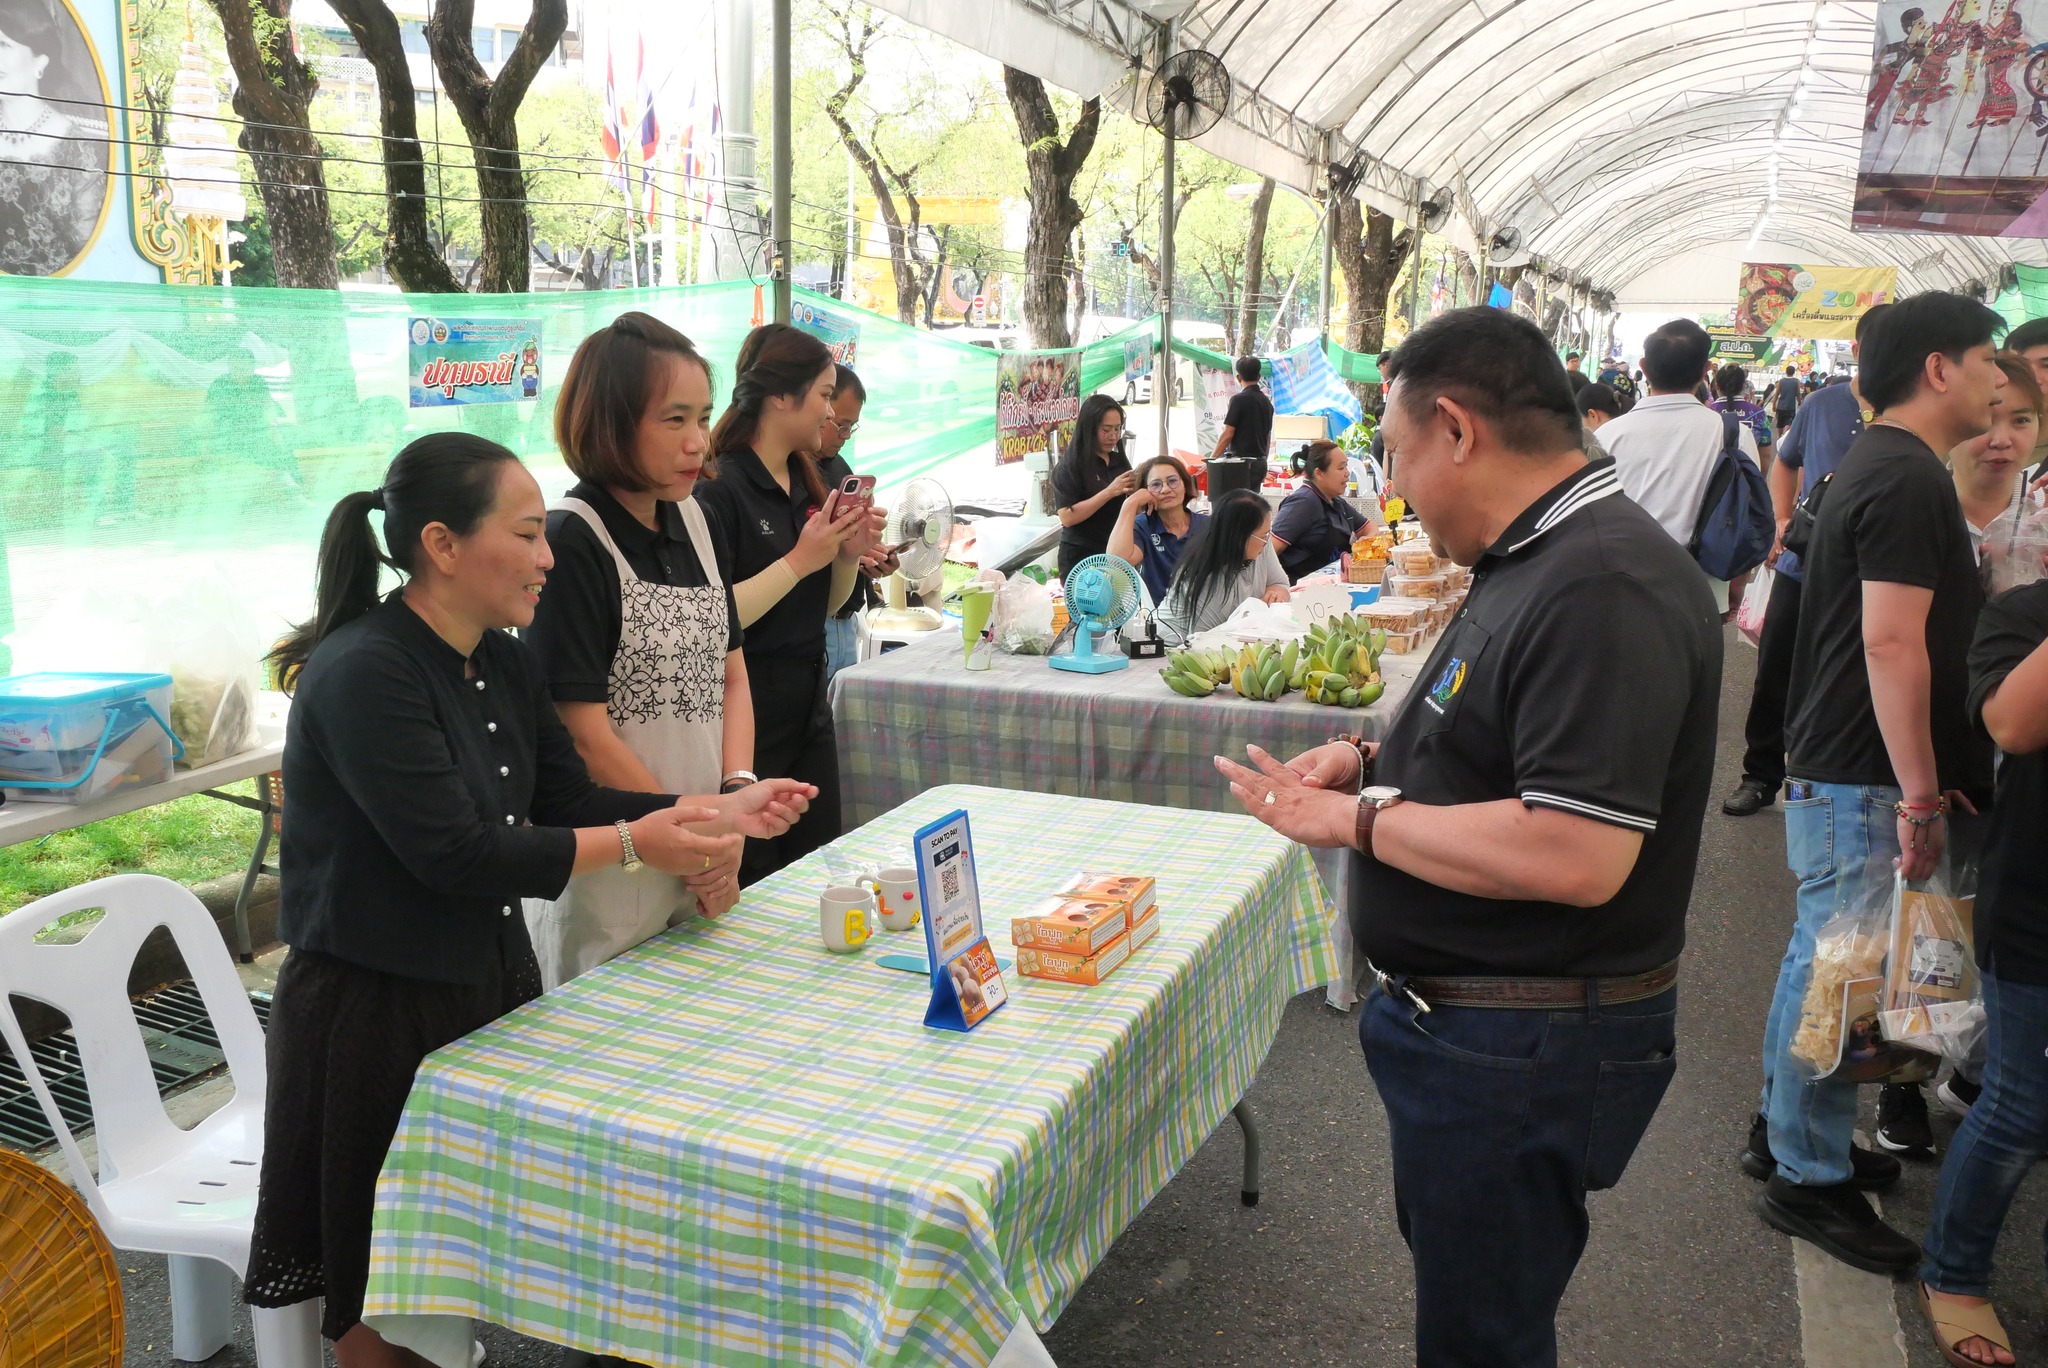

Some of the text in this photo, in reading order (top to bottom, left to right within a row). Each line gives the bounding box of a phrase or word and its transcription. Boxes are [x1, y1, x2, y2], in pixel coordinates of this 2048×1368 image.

[1820, 289, 1887, 307] ZONE
[423, 353, 516, 398] ปทุมธานี
[1003, 436, 1032, 459] KRABI
[931, 827, 958, 848] SCAN TO PAY
[845, 909, 867, 945] B
